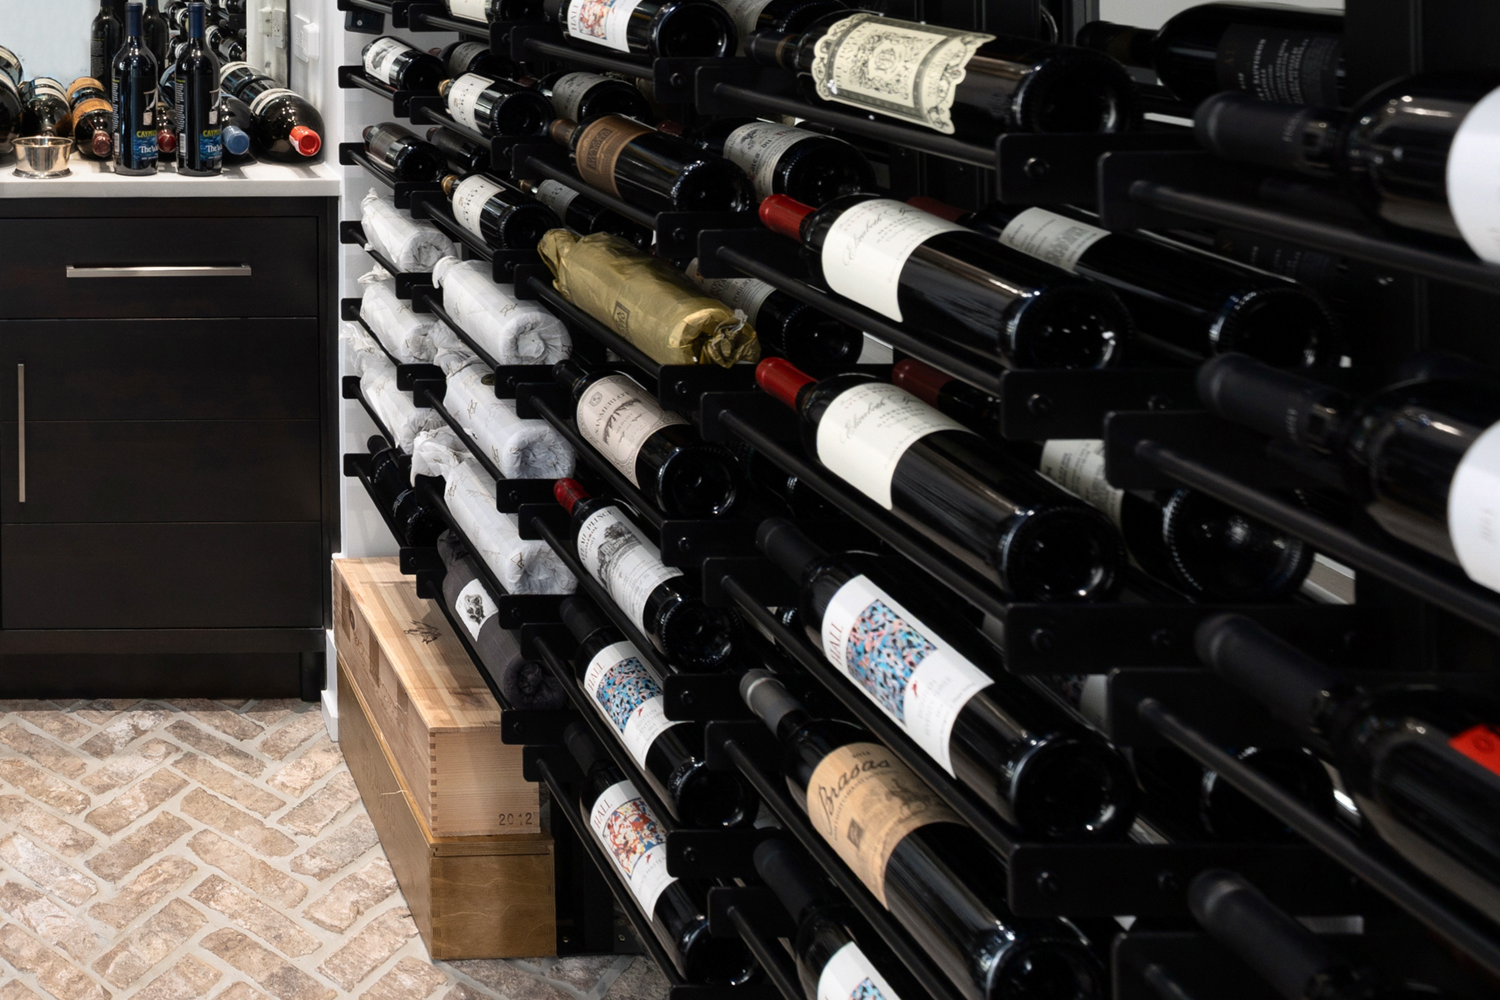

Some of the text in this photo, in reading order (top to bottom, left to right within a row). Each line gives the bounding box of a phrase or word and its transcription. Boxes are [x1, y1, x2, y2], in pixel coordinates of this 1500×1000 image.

[138, 145, 151, 154] The
[205, 144, 217, 153] The
[595, 391, 630, 436] SANMERLOT
[586, 509, 615, 531] PLINCE
[829, 623, 844, 666] HALL
[588, 662, 605, 691] HALL
[817, 758, 892, 836] Brasas
[498, 812, 533, 826] 2012
[593, 799, 613, 829] HALL
